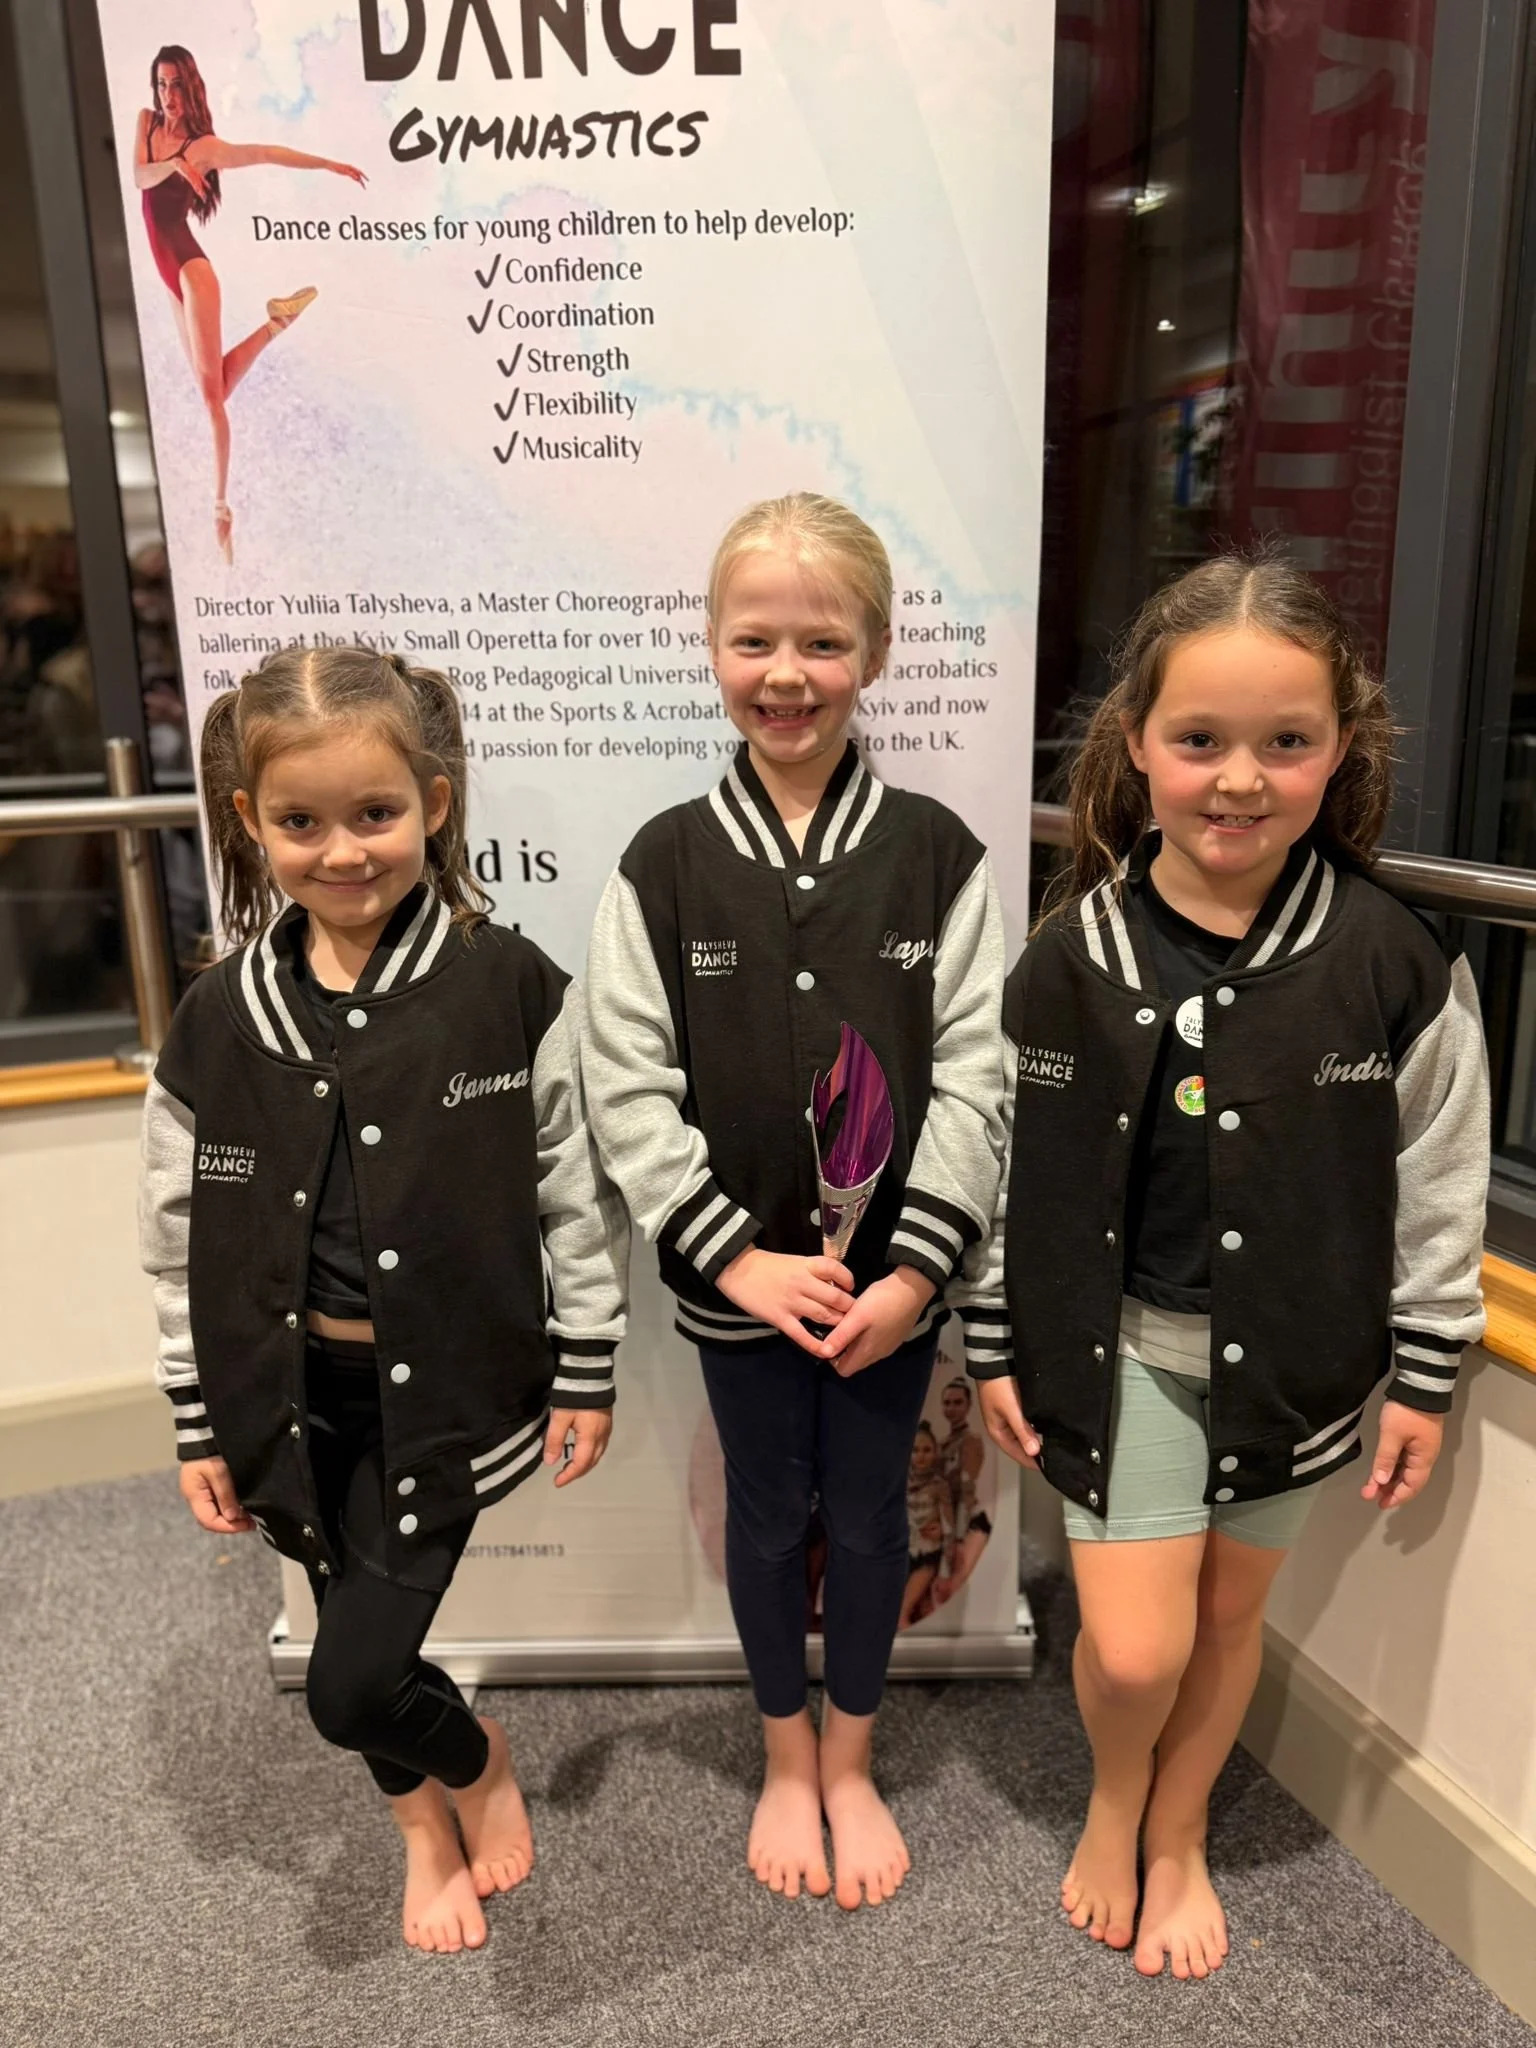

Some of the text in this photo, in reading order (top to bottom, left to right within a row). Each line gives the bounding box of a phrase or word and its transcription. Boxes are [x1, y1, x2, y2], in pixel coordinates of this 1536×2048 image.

[359, 0, 742, 81] DANCE
[389, 107, 709, 164] GYMNASTICS
[252, 207, 855, 246] Dance classes for young children to help develop:
[505, 257, 643, 284] Confidence
[497, 302, 655, 329] Coordination
[527, 347, 630, 378] Strength
[523, 391, 637, 421] Flexibility
[523, 434, 643, 465] Musicality
[194, 596, 275, 618] Director
[279, 594, 340, 616] Yuliia
[346, 592, 455, 619] Talysheva,
[460, 597, 472, 613] a
[478, 592, 550, 613] Master
[902, 589, 925, 605] as
[931, 589, 942, 604] a
[198, 621, 987, 655] ballerina at the Kyiv Small Operetta for over 10 yea teaching
[203, 669, 238, 690] folk
[448, 666, 488, 692] Rog
[493, 665, 612, 691] Pedagogical
[619, 663, 720, 690] University
[894, 659, 998, 680] acrobatics
[462, 702, 481, 722] 14
[487, 704, 507, 722] at
[513, 702, 544, 722] the
[550, 700, 616, 726] Sports
[622, 700, 636, 721] &
[856, 695, 898, 722] Kyiv
[904, 695, 941, 716] and
[947, 698, 990, 715] now
[482, 738, 558, 762] passion
[564, 737, 593, 757] for
[599, 735, 708, 760] developing
[864, 734, 885, 752] to
[891, 731, 922, 751] the
[930, 730, 965, 751] UK.
[517, 838, 559, 884] is
[691, 951, 738, 968] DANCE
[692, 940, 737, 951] TALYSHEVA
[879, 930, 934, 970] Lay
[1019, 1055, 1074, 1081] DANCE
[1021, 1044, 1075, 1065] TALYSHEVA
[442, 1067, 530, 1108] Janna
[198, 1154, 255, 1176] DANCE
[201, 1143, 256, 1158] TALYSHEVA
